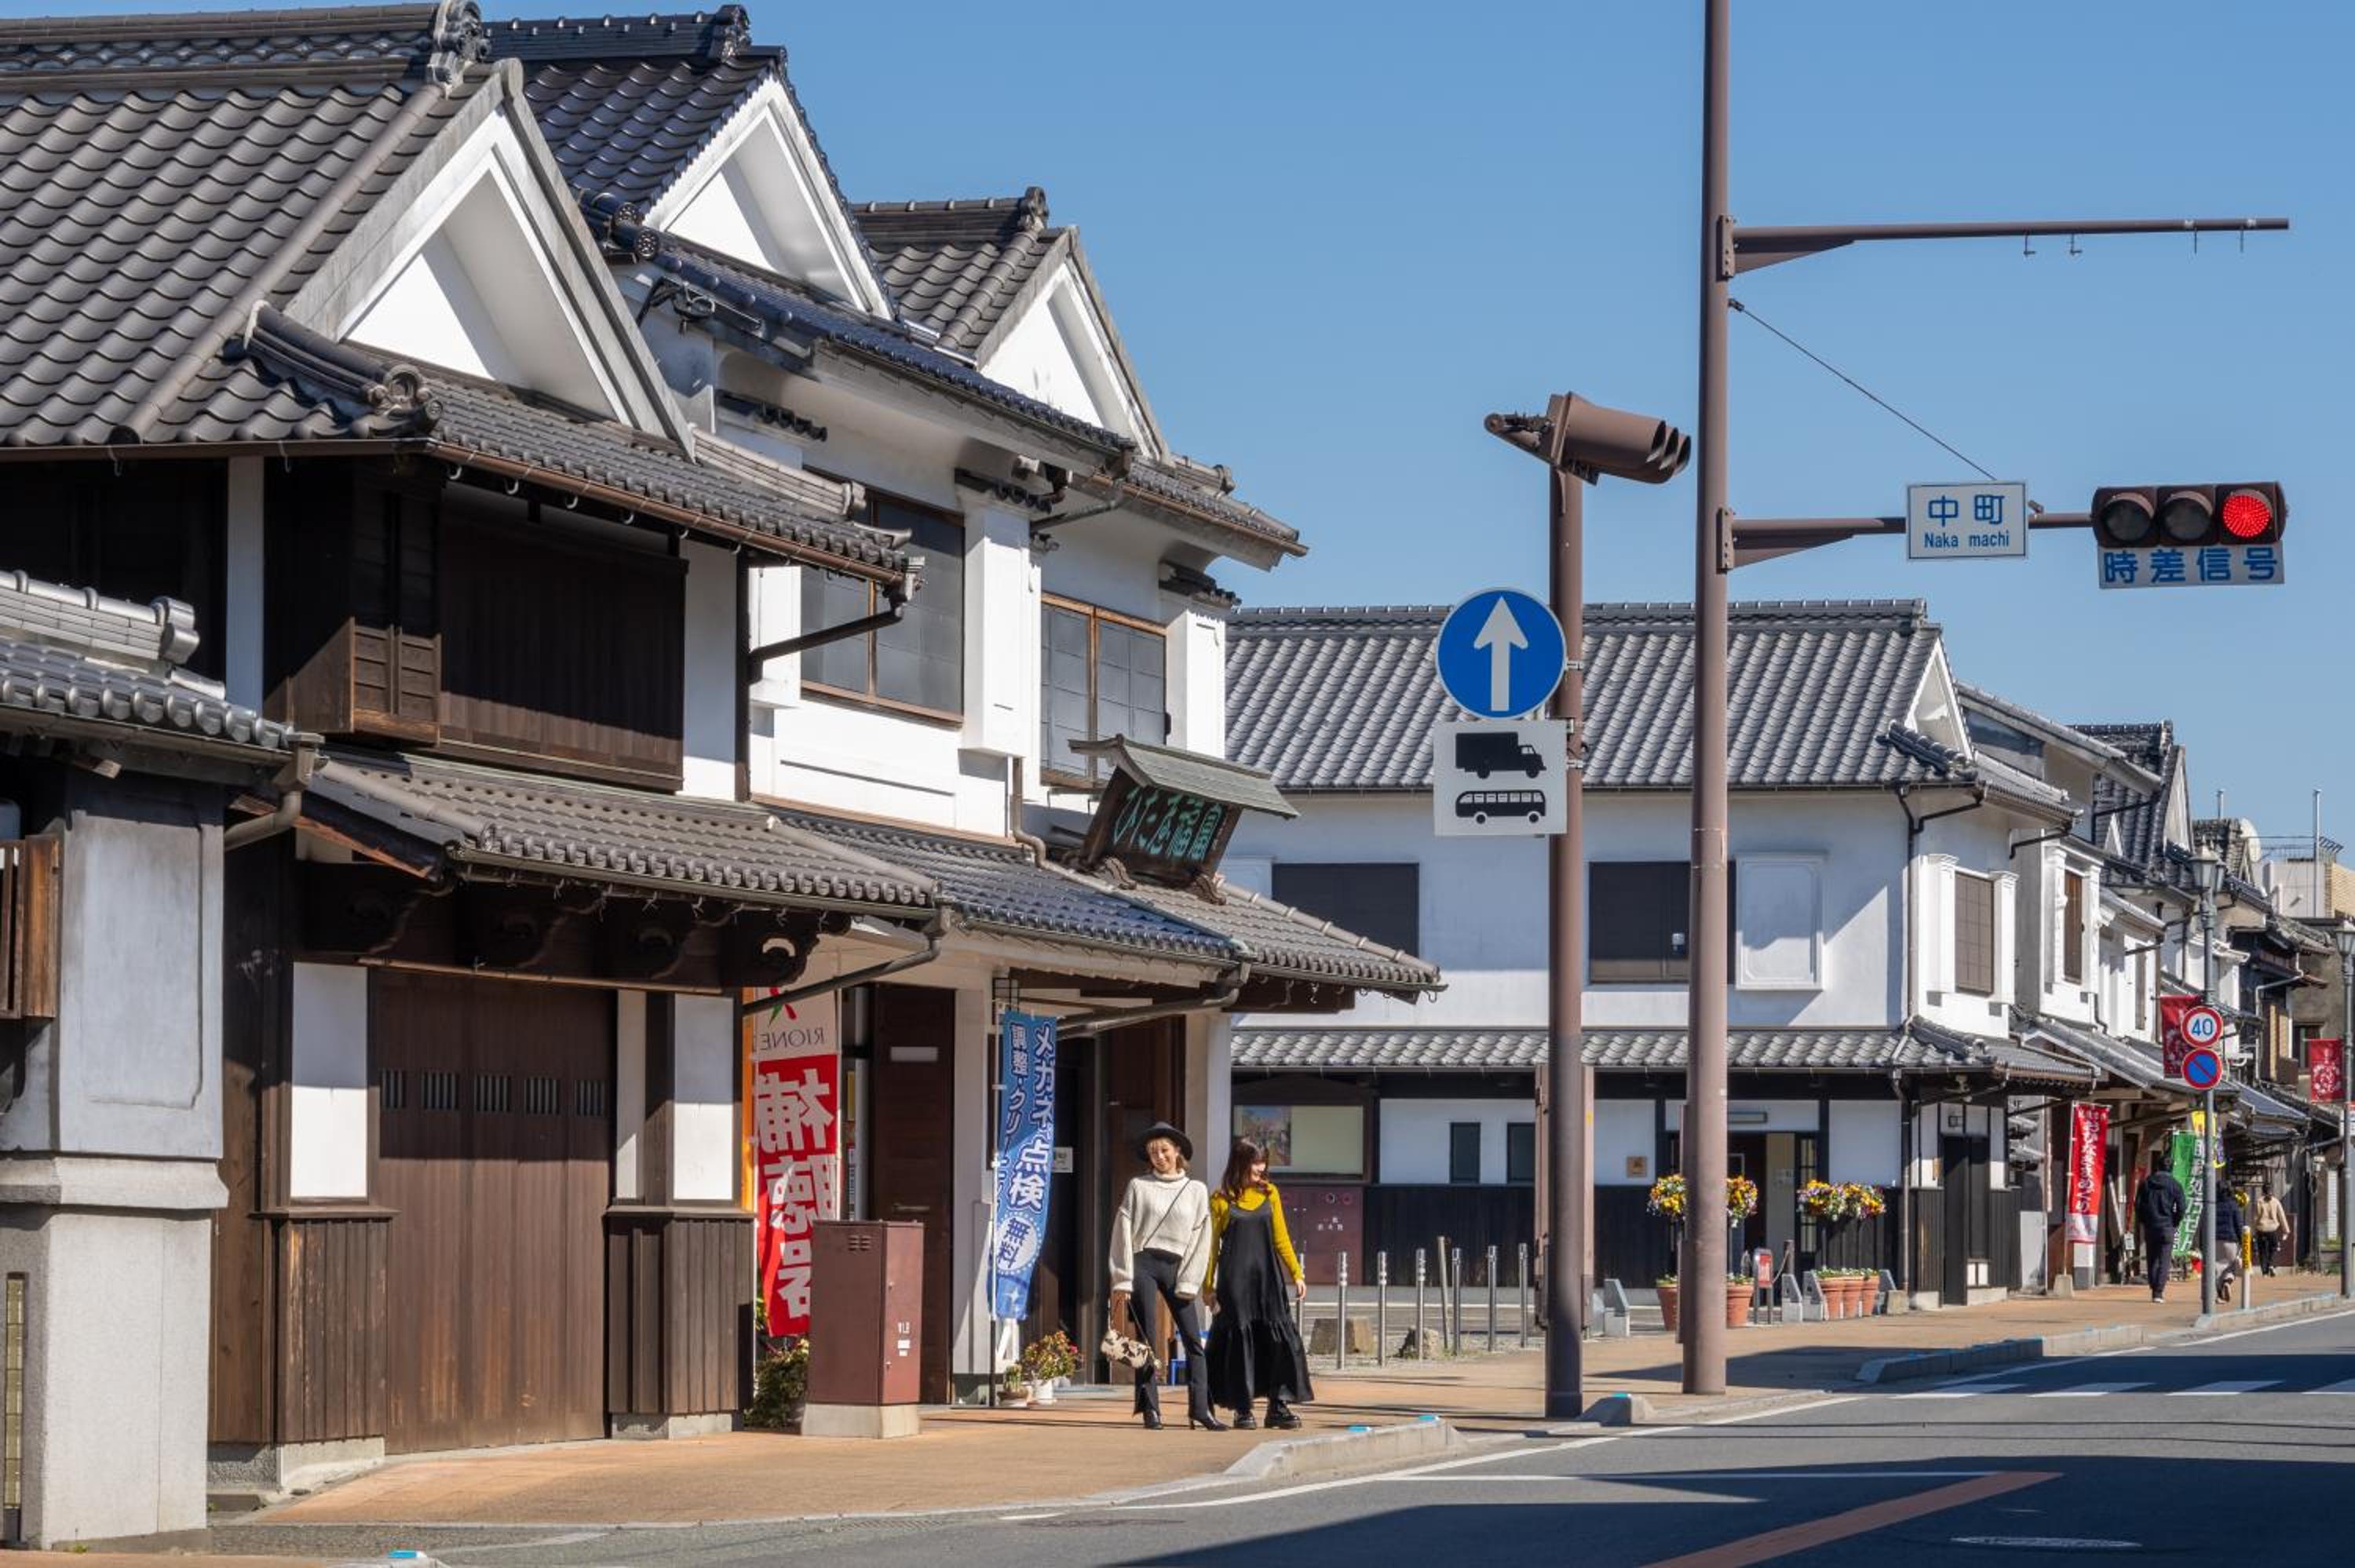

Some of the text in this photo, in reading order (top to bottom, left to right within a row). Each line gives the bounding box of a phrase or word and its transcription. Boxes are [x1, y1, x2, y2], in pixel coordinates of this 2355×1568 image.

[1929, 494, 2005, 527] 中町
[1925, 531, 2010, 548] Naka machi
[2104, 549, 2277, 583] 時差信号
[2191, 1018, 2213, 1036] 40
[998, 1217, 1031, 1268] 無料
